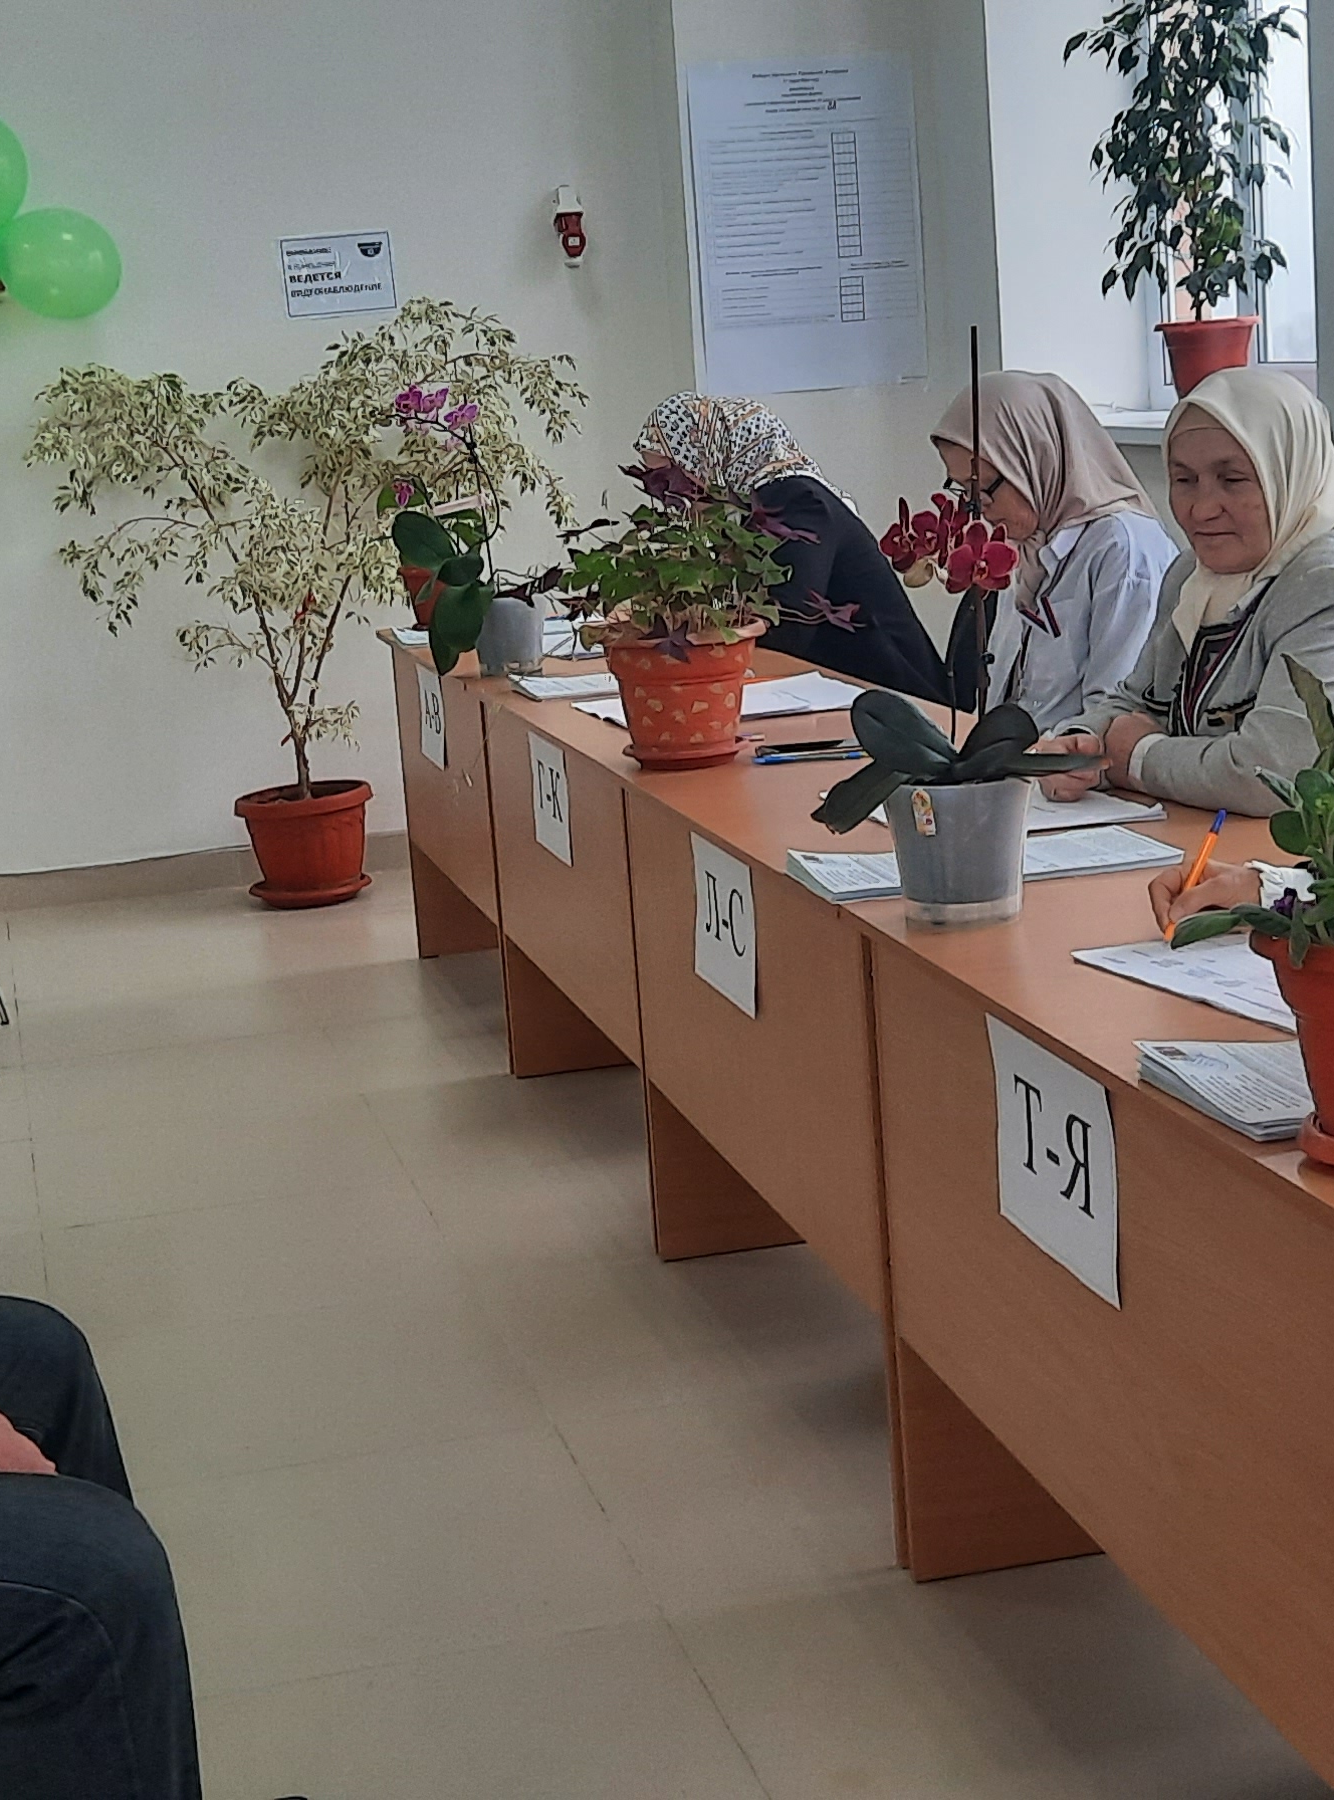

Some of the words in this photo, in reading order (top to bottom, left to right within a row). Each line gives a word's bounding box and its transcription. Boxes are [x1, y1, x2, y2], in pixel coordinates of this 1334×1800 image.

[289, 271, 342, 284] ВЕДЕТСЯ
[290, 282, 383, 299] ВИДЕОНАБЛЮДЕНИЕ
[536, 758, 564, 824] Г-К
[704, 870, 747, 958] Л-С
[1013, 1073, 1096, 1220] Т-Я
